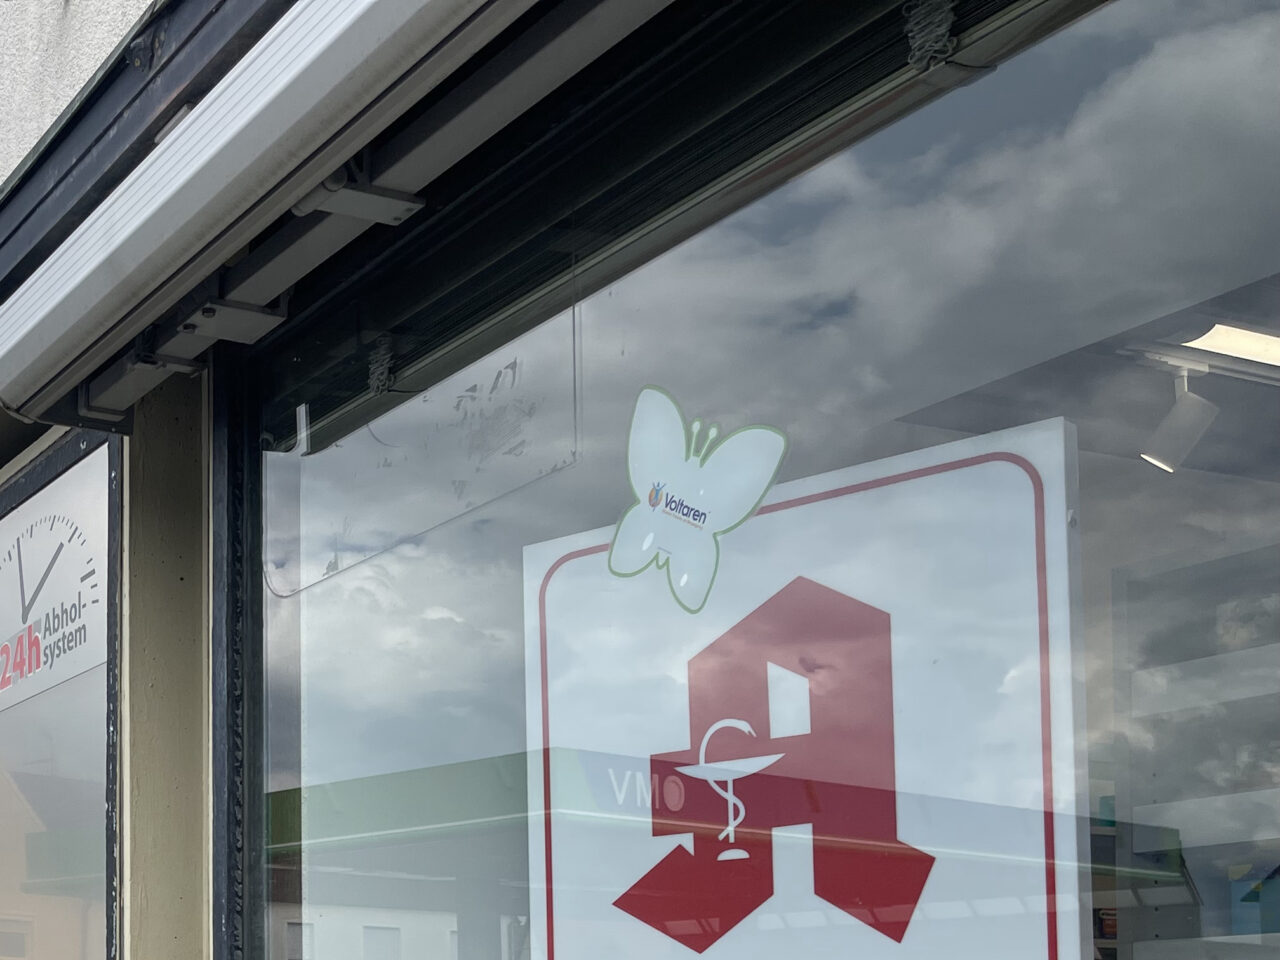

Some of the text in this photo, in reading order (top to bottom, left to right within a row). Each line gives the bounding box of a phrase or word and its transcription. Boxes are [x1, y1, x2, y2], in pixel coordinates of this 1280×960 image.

[665, 492, 707, 525] Voltaren
[0, 591, 87, 691] 24h Abhol-
[43, 624, 87, 670] system
